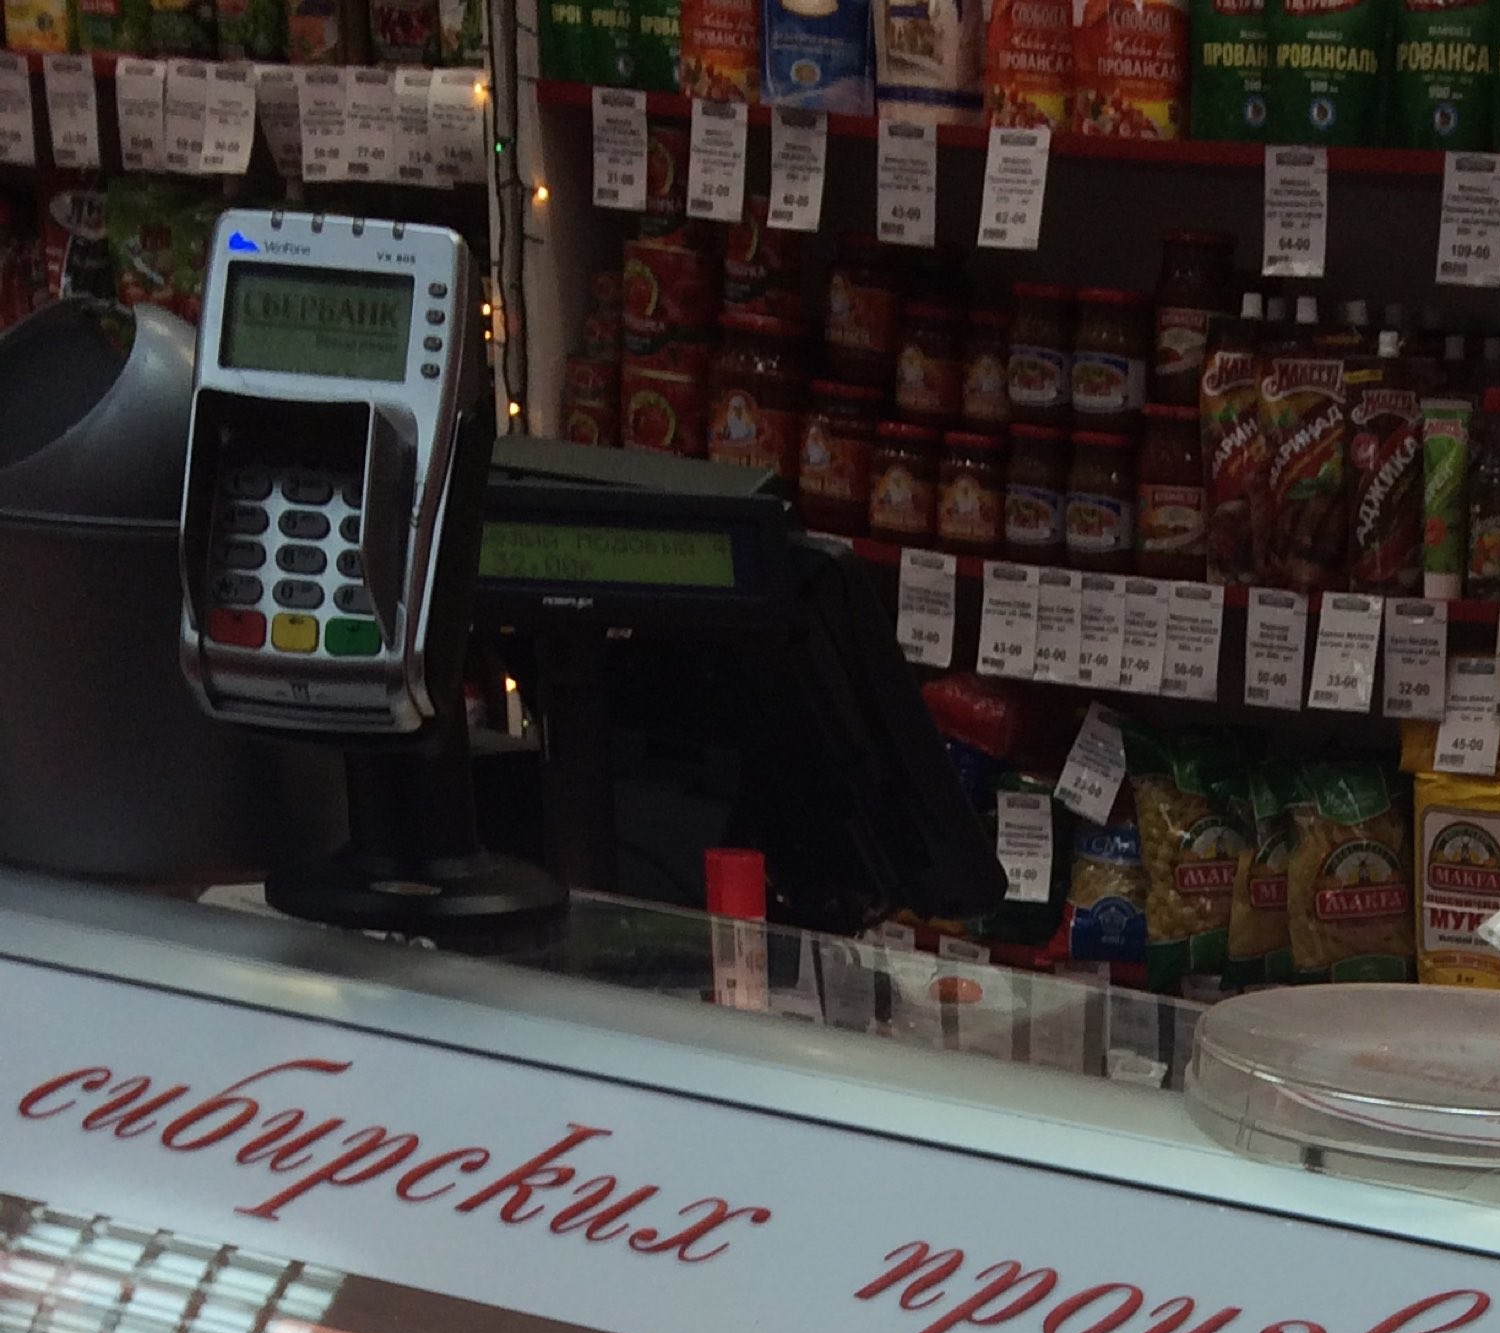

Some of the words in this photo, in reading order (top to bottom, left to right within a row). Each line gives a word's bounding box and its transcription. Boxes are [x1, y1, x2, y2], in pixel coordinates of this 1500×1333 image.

[1203, 43, 1268, 67] ПРОВАН
[1452, 737, 1485, 752] 45-00
[1430, 908, 1482, 932] МУК
[18, 1058, 772, 1263] сибирских
